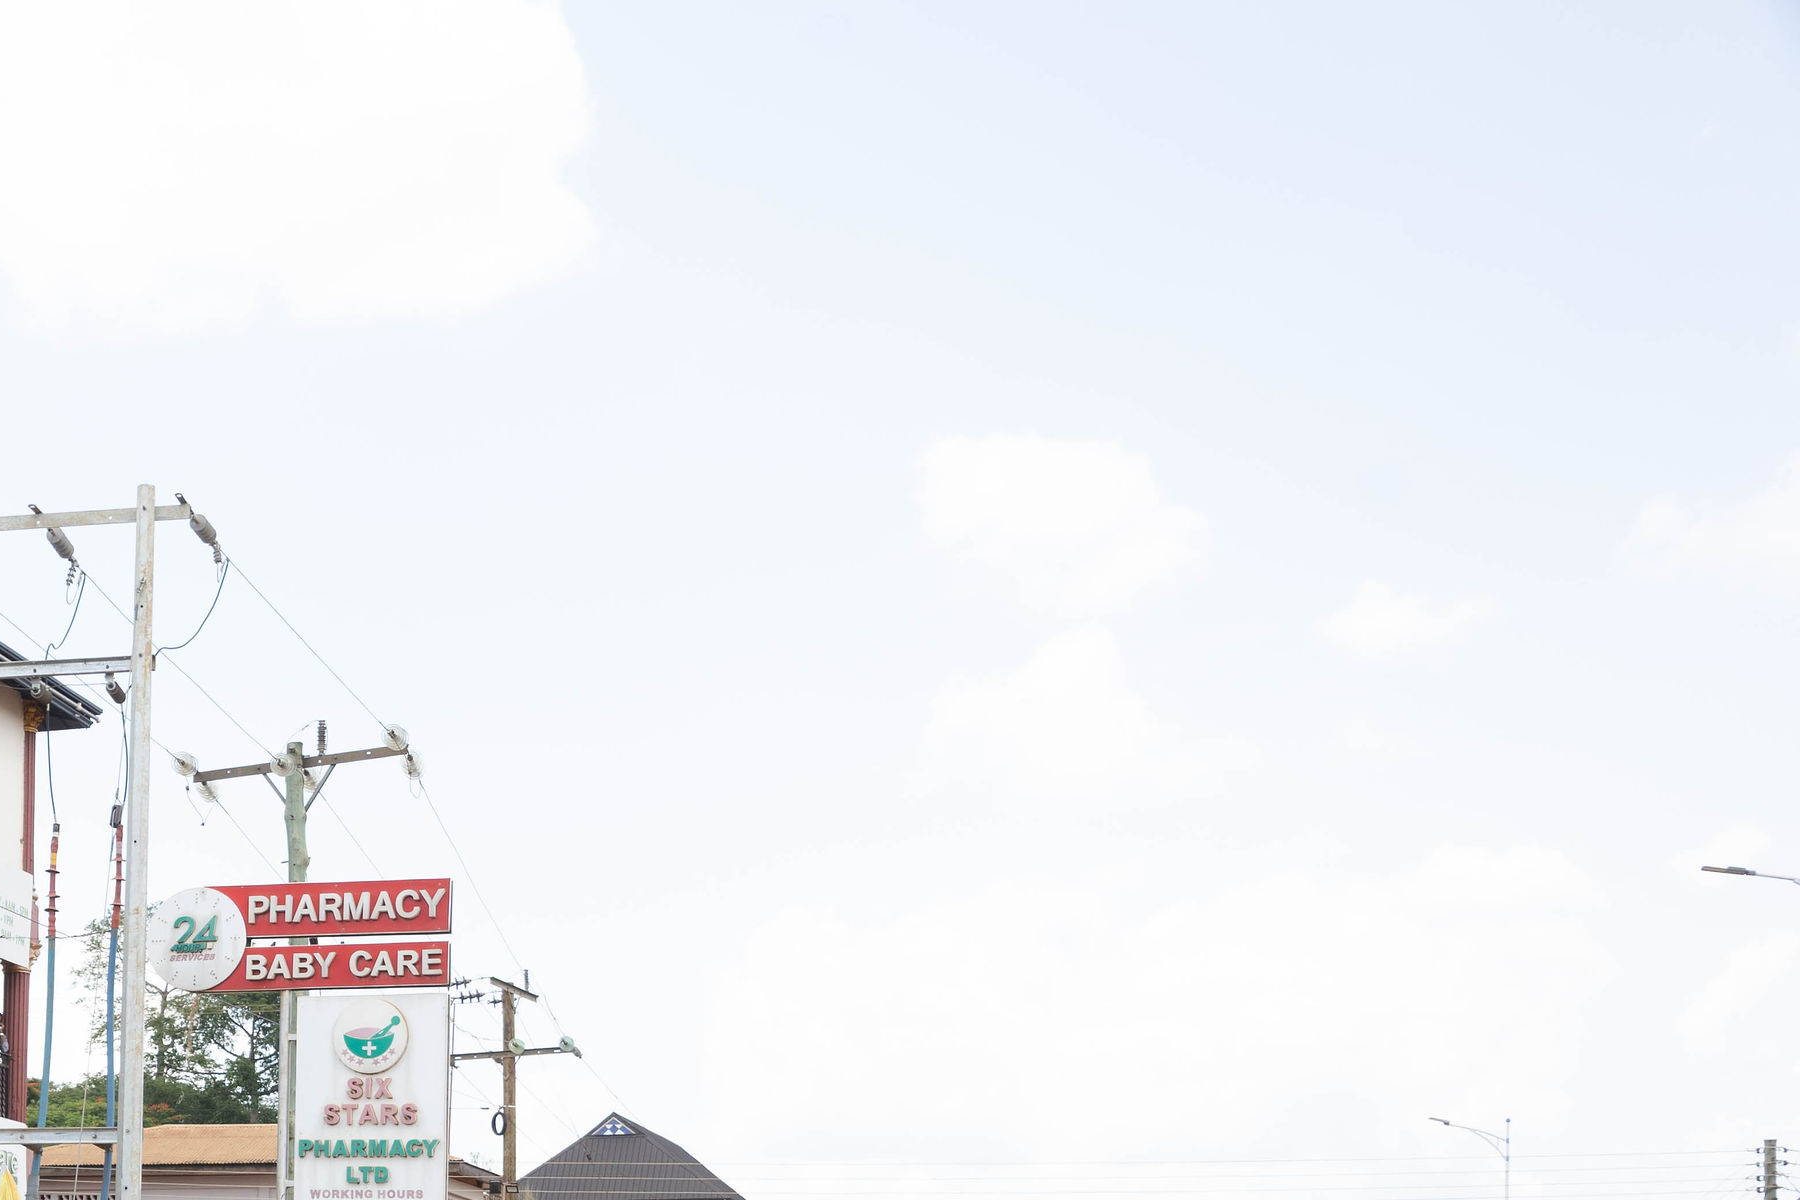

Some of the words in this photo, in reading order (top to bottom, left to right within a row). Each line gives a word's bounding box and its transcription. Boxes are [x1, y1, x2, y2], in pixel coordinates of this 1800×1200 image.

[248, 888, 446, 925] PHARMACY
[173, 914, 218, 944] 24
[169, 953, 215, 962] SERVICES
[245, 951, 337, 981] BABY
[349, 948, 444, 978] CARE
[346, 1077, 393, 1100] SIX
[323, 1103, 419, 1126] STARS
[298, 1138, 440, 1159] PHARMACY
[346, 1166, 390, 1185] LTD
[310, 1189, 373, 1200] WORKING
[377, 1189, 424, 1200] HOURS
